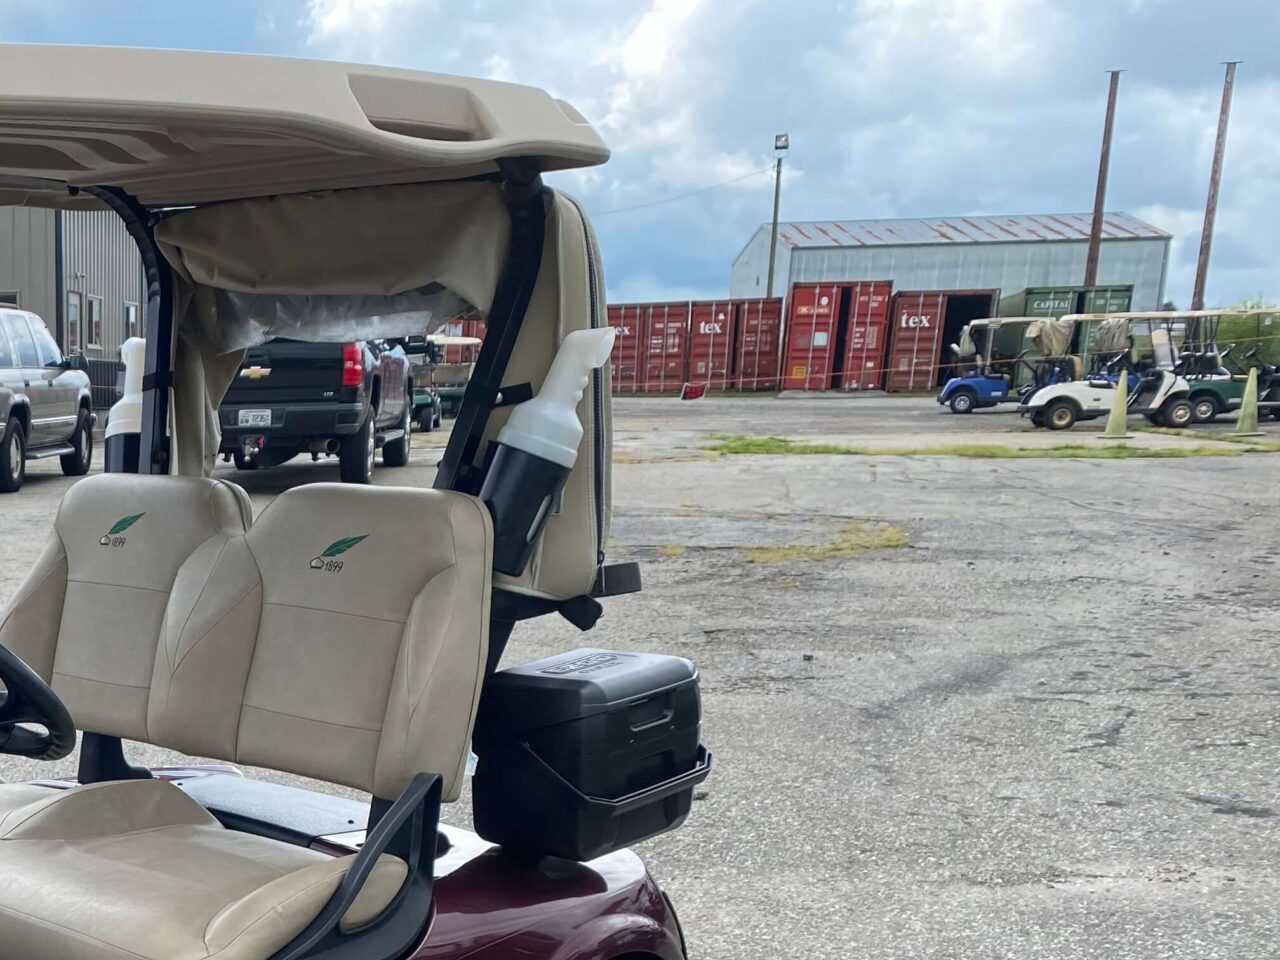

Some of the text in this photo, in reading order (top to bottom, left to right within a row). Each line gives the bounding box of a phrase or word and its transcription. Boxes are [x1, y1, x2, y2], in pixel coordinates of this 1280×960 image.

[1033, 300, 1070, 309] CAPITAL
[901, 312, 931, 328] tex
[613, 325, 630, 335] ex
[699, 321, 722, 334] tex
[325, 560, 344, 573] 1899
